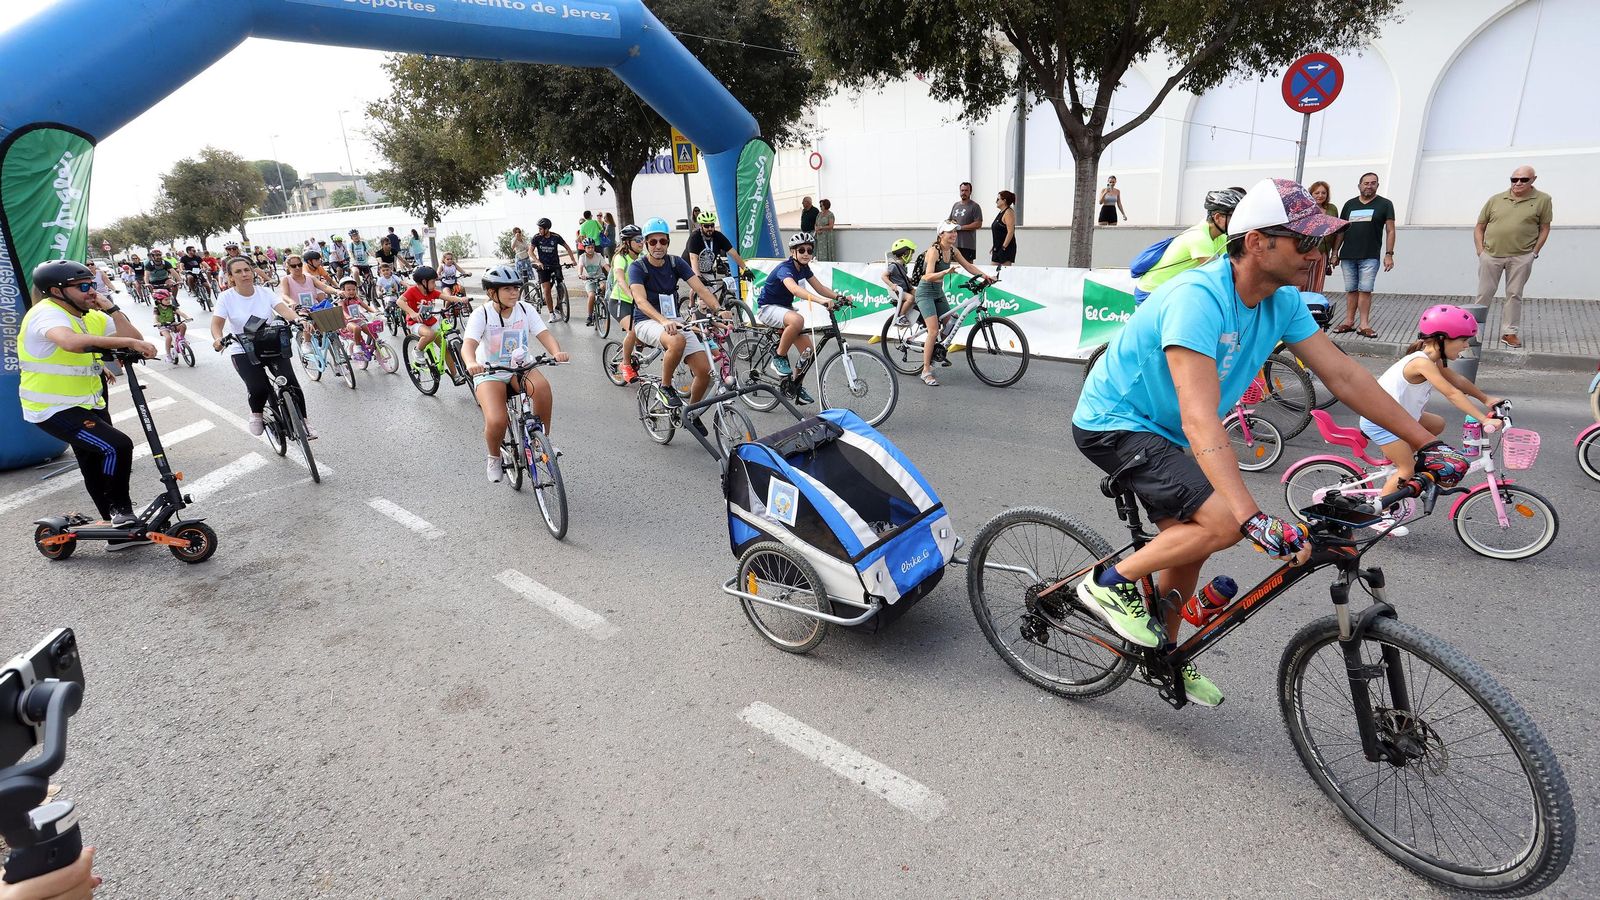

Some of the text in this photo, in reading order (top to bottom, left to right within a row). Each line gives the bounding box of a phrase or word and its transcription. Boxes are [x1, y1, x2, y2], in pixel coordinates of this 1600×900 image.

[531, 2, 556, 14] de
[561, 5, 612, 20] Jerez
[42, 151, 82, 229] Inglés
[1085, 306, 1130, 322] El Corte
